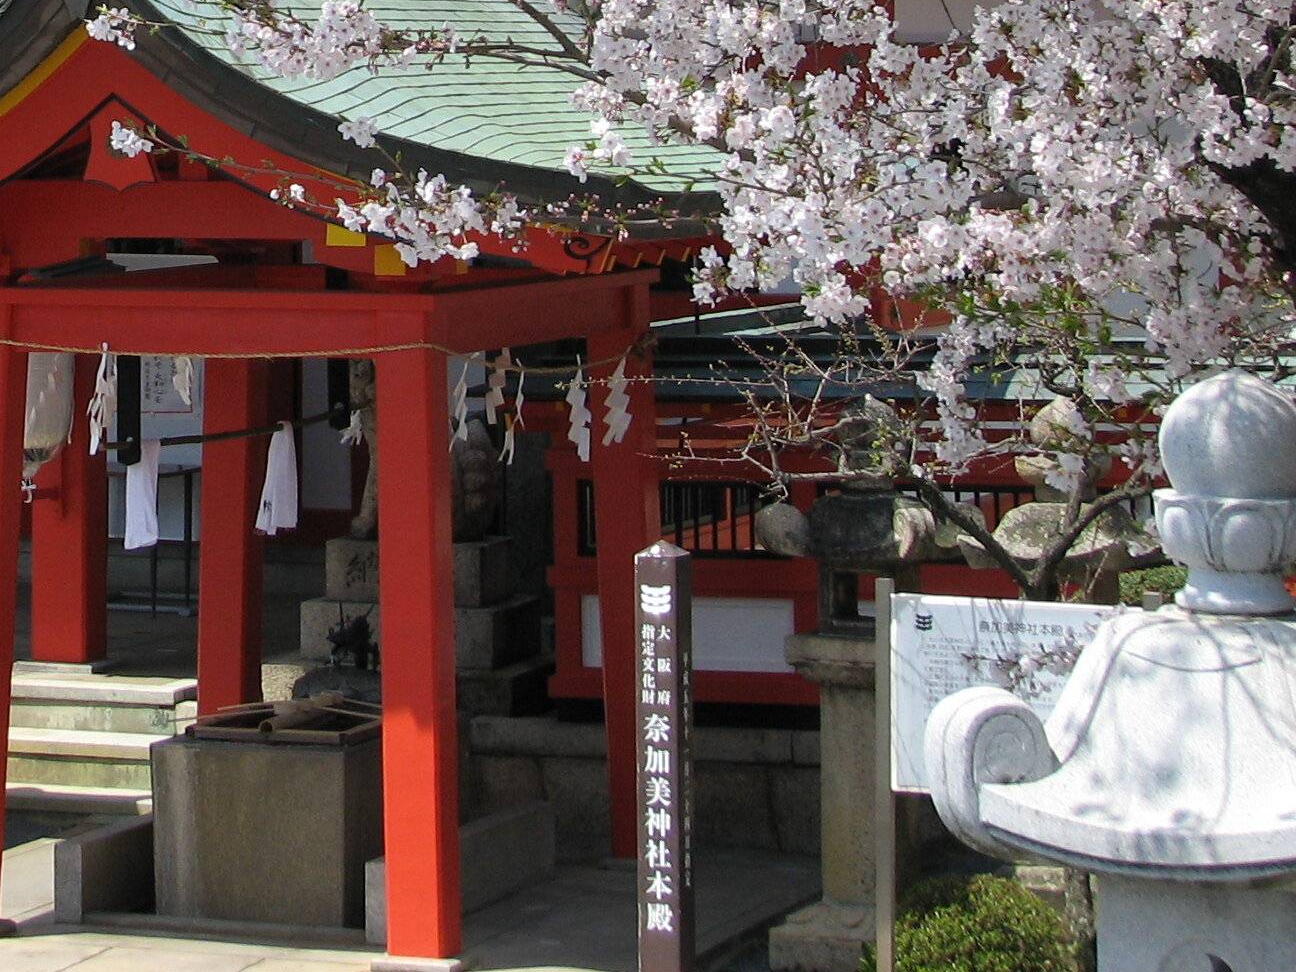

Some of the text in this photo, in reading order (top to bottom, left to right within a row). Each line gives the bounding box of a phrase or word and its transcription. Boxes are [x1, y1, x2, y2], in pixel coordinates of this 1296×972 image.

[640, 623, 656, 706] 指定文化財
[656, 624, 672, 706] 大阪府
[643, 712, 674, 933] 奈加美神社本殿
